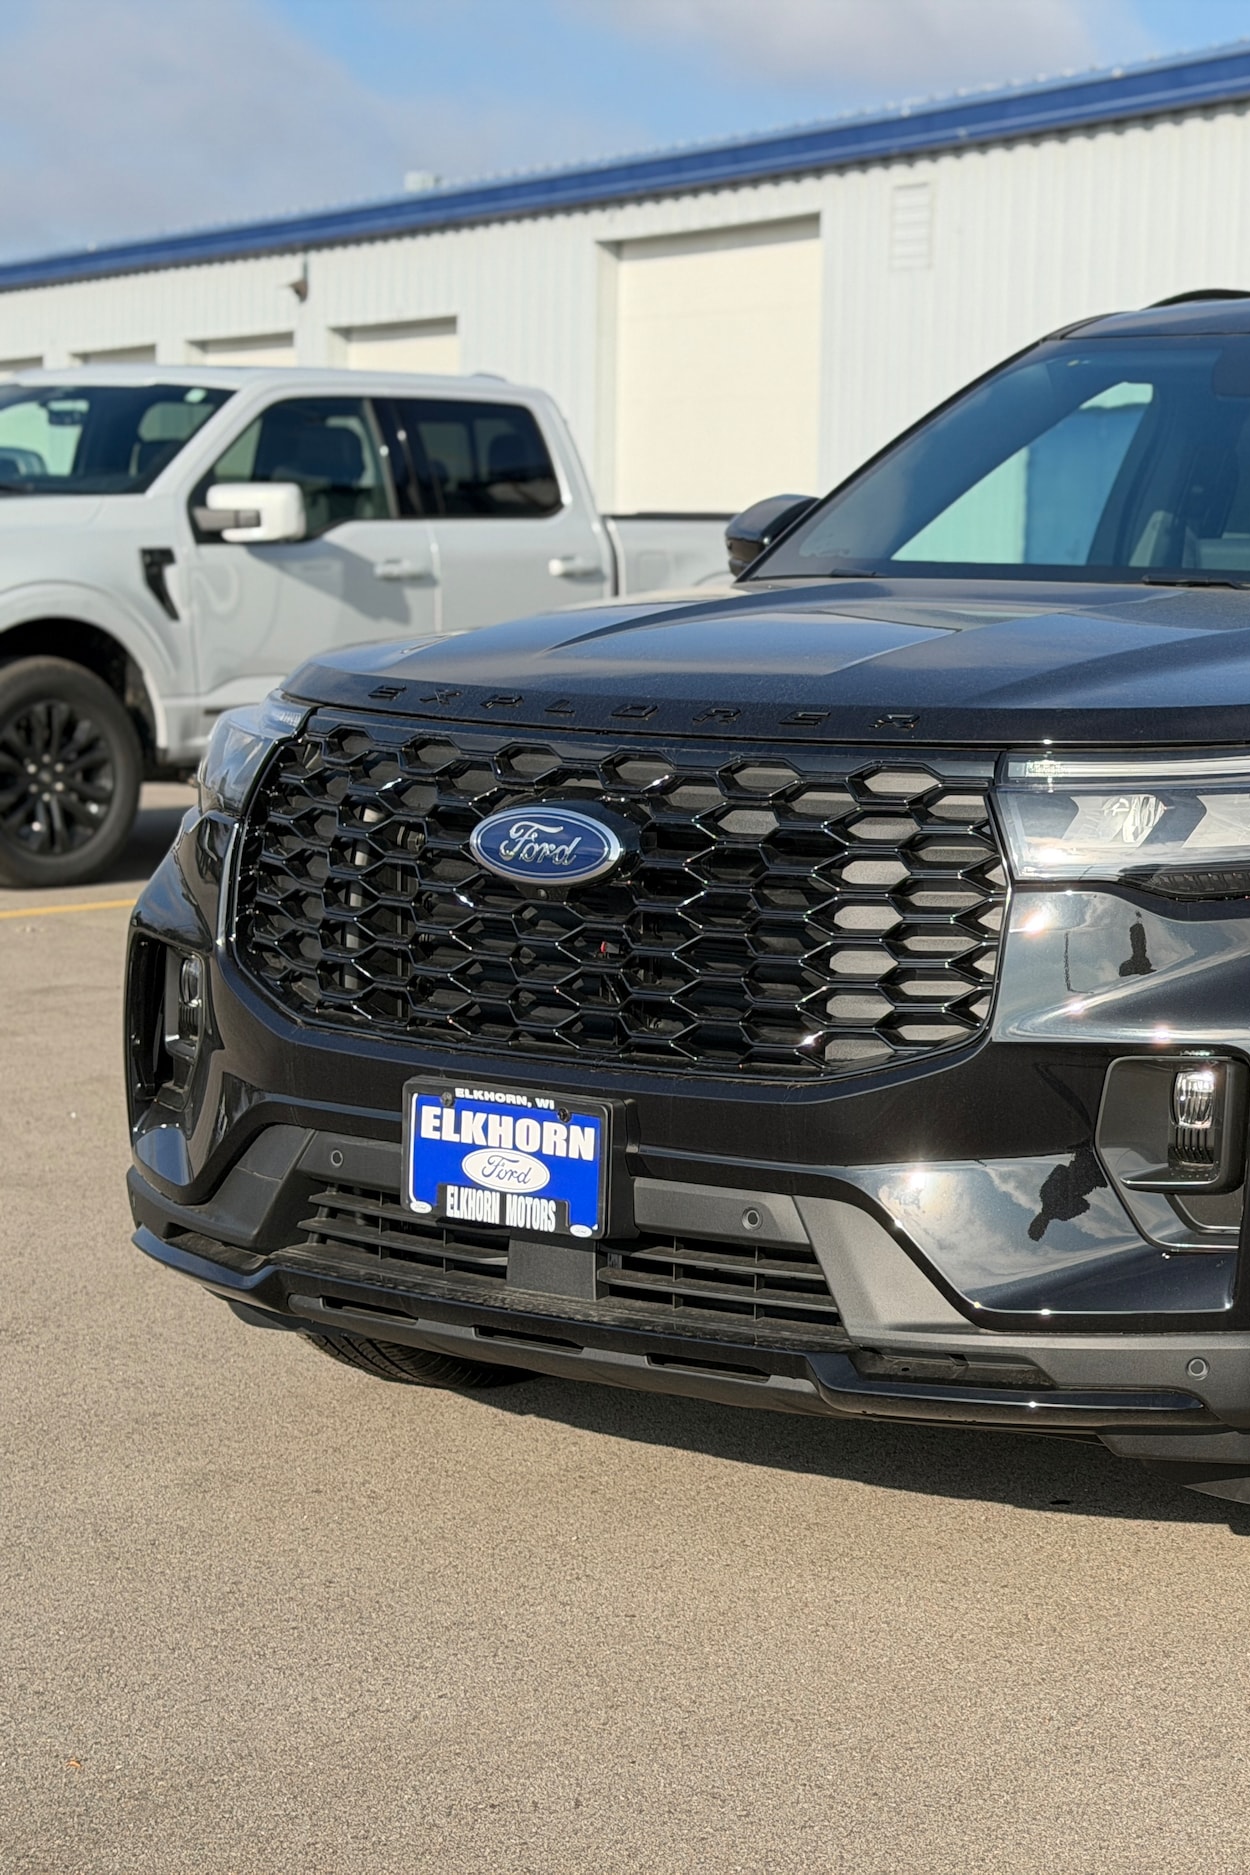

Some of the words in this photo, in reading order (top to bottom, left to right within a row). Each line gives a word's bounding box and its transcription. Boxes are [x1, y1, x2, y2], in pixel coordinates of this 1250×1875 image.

[368, 685, 921, 730] EXPLORER
[499, 821, 582, 866] Ford
[455, 1087, 532, 1108] ELKHORN,
[535, 1098, 555, 1110] WI
[420, 1105, 596, 1161] ELKHORN
[481, 1154, 532, 1185] Ford
[446, 1185, 501, 1225] ELKHORN
[505, 1193, 556, 1232] MOTORS
